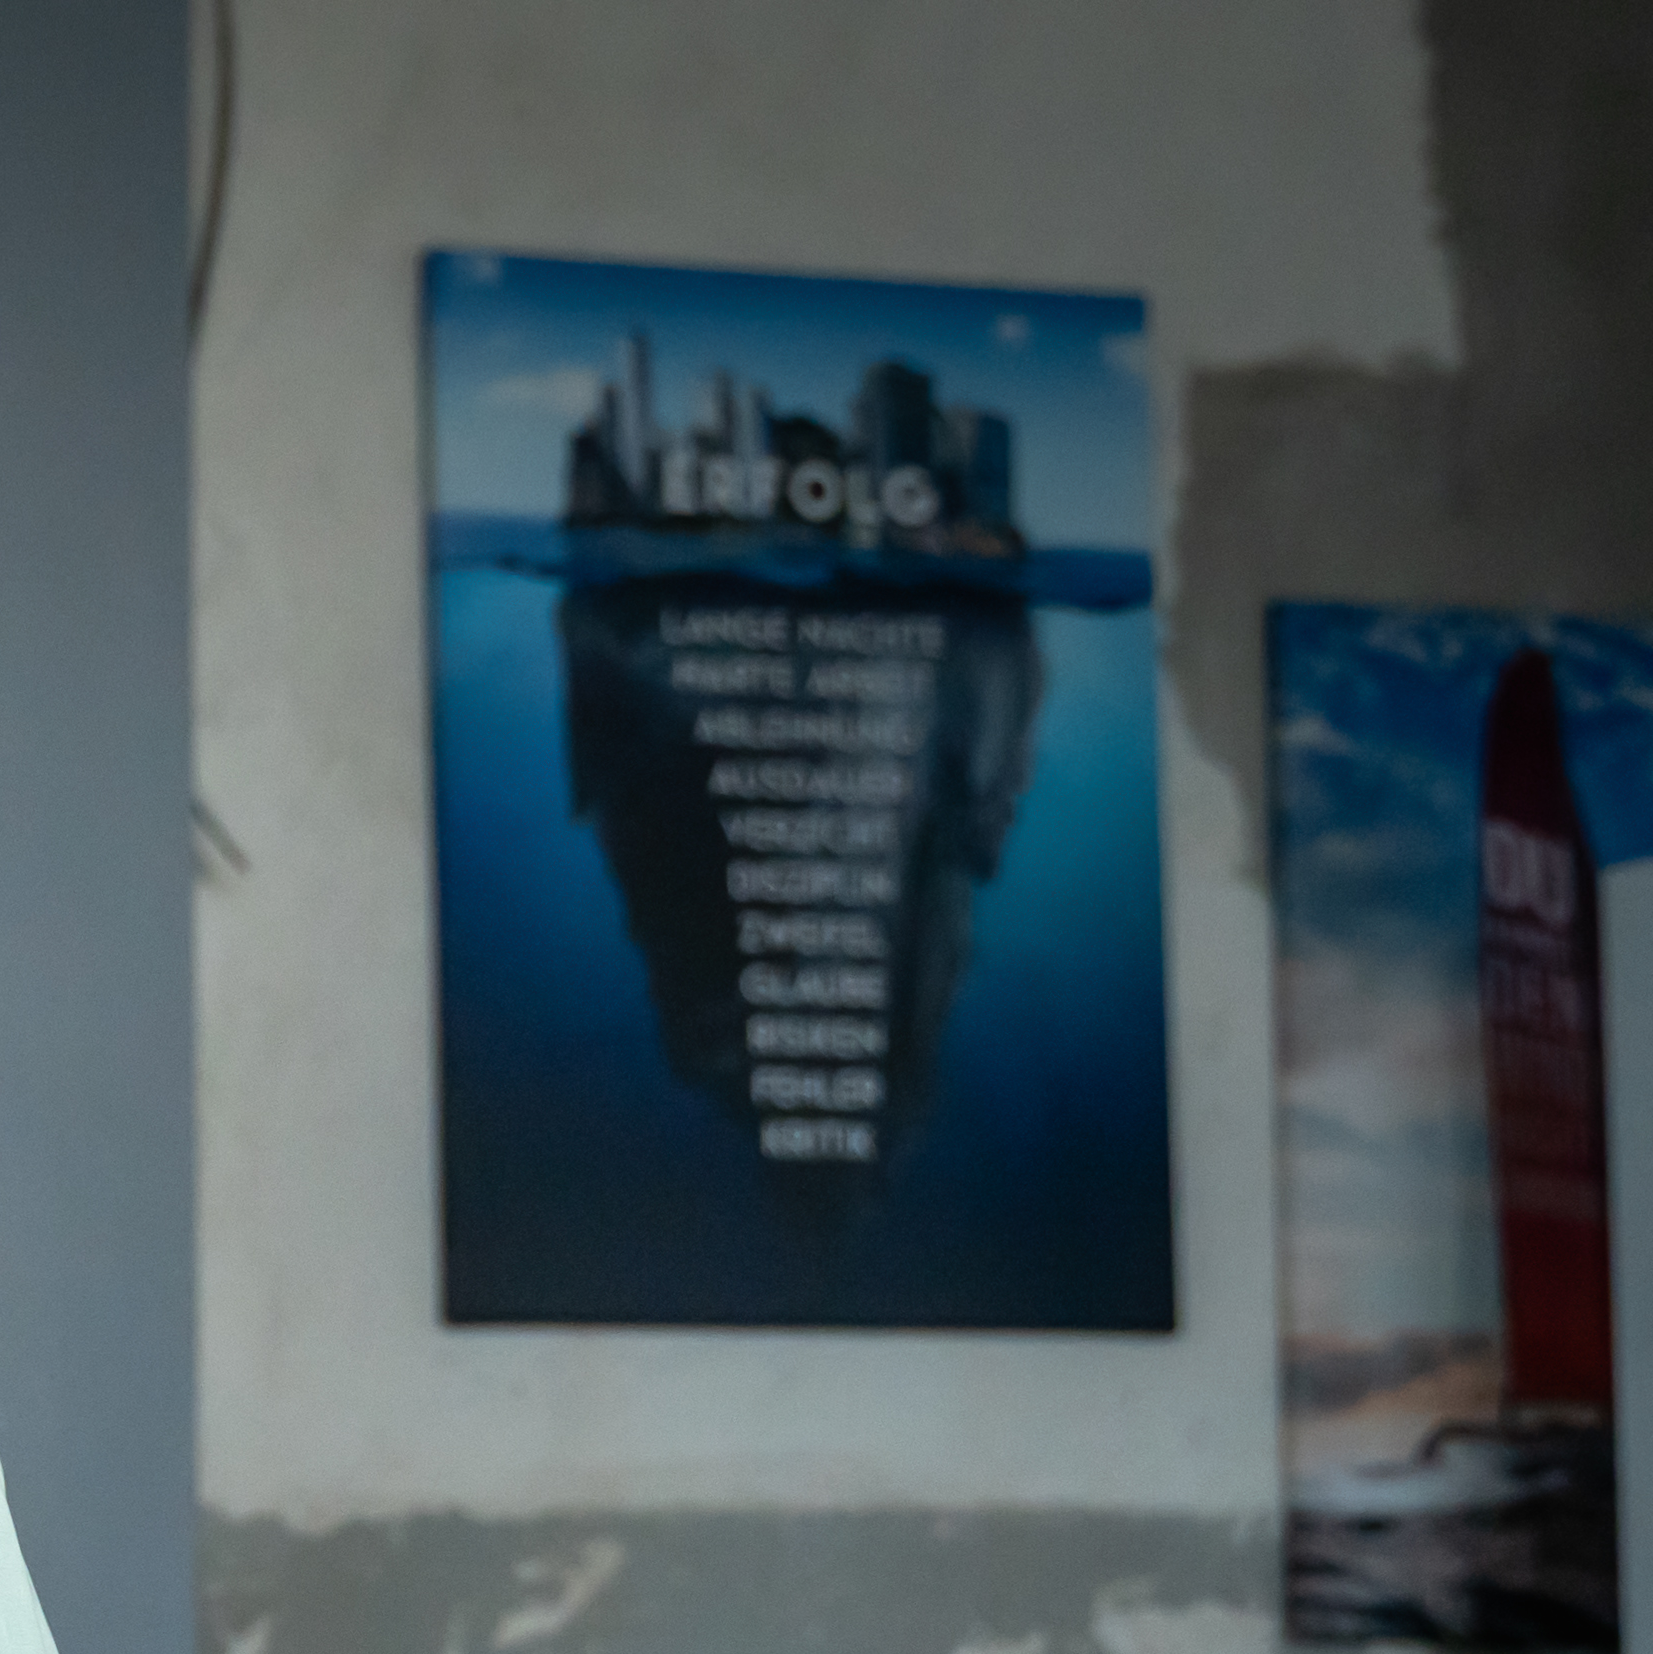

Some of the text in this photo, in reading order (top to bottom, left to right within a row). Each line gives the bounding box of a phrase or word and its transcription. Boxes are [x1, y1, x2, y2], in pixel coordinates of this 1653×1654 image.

[664, 455, 939, 525] ERFOLG
[661, 609, 786, 649] LANGE
[708, 760, 910, 803] AUSDAUER
[740, 964, 887, 1007] GLAUBE
[751, 1067, 885, 1109] FEHLER
[761, 1119, 876, 1158] KRITIK
